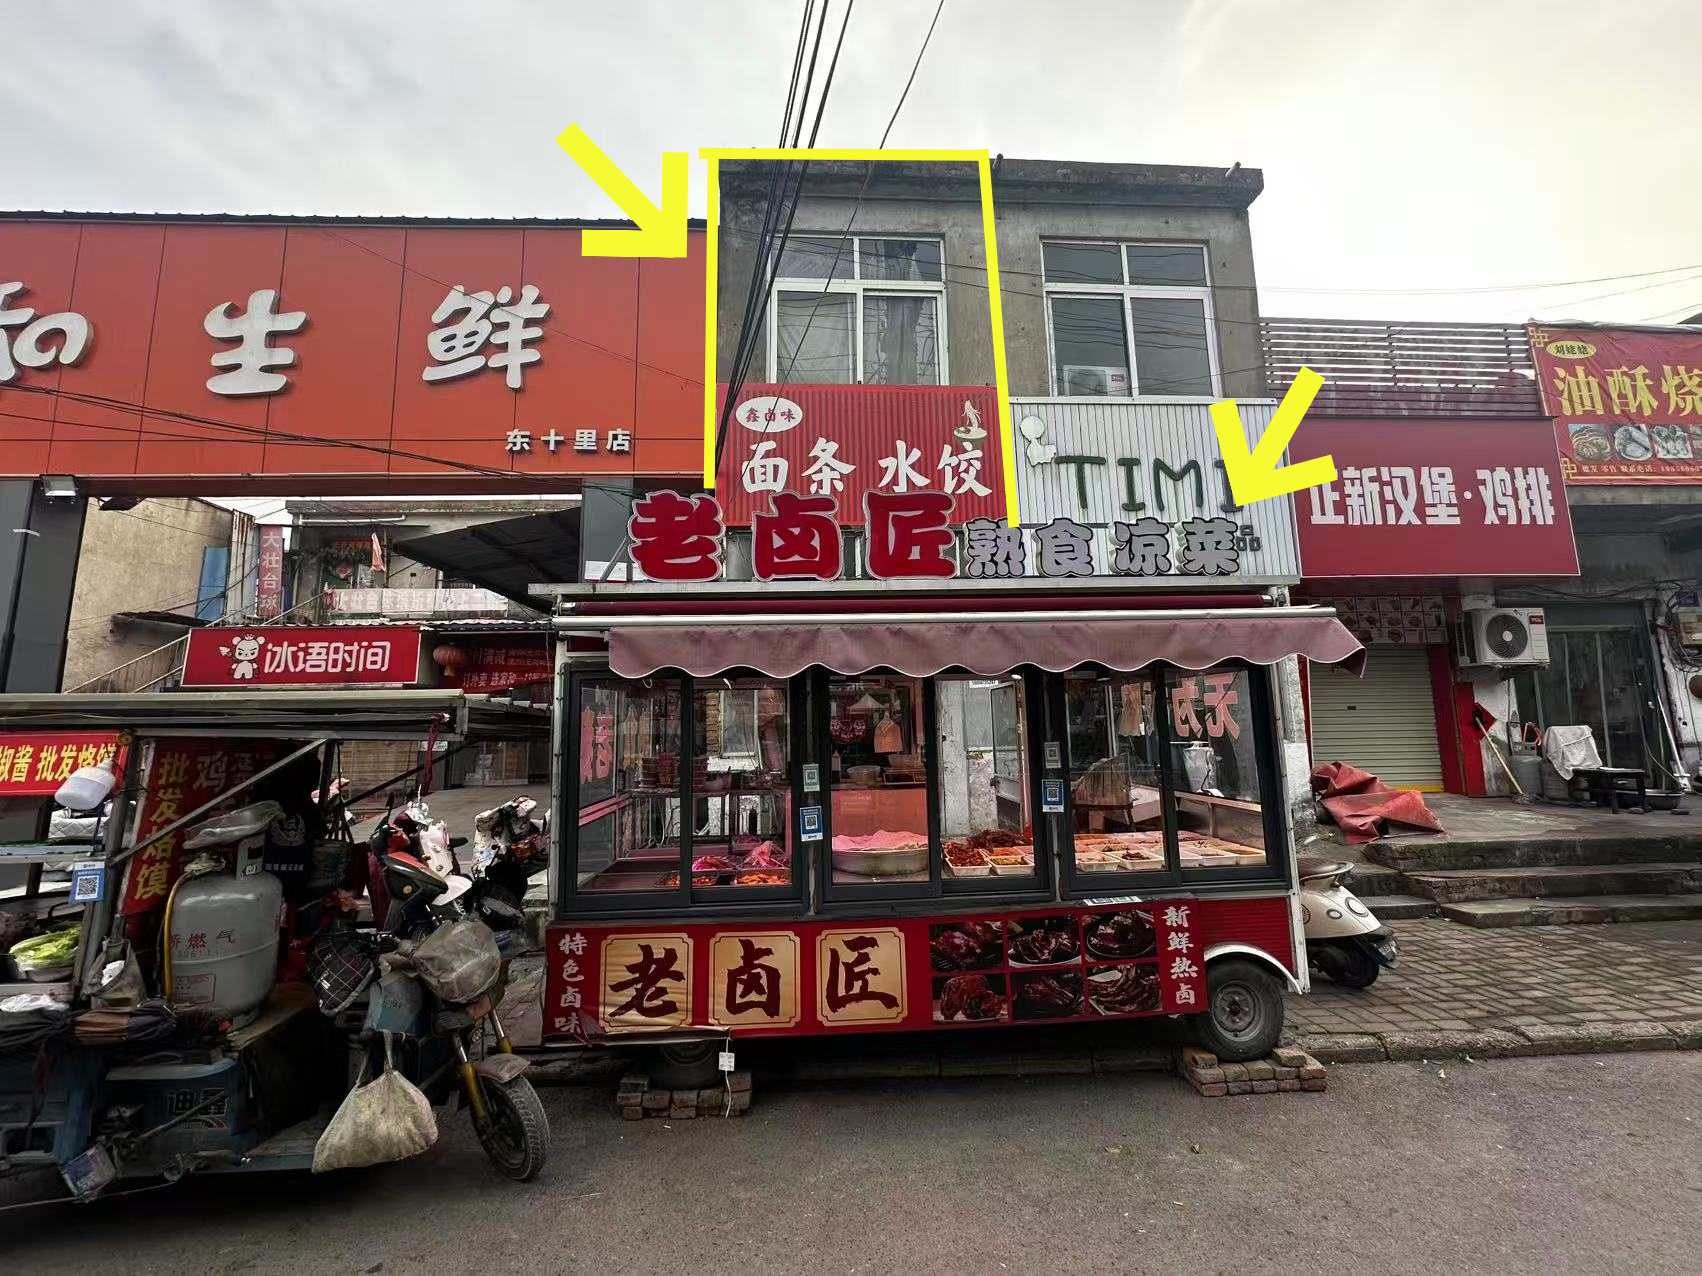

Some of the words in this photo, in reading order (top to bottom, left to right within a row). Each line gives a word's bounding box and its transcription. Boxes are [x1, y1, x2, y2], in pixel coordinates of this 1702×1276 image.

[505, 428, 632, 454] 东十里店
[745, 407, 796, 422] 鑫卤味
[741, 437, 856, 495] 面条
[878, 440, 992, 497] 水饺
[629, 489, 957, 581] 老卤匠
[965, 516, 1241, 578] 熟食凉菜
[264, 641, 391, 673] 冰语时间
[555, 932, 588, 1033] 特色卤味
[607, 936, 899, 1018] 老卤匠
[1161, 906, 1198, 1004] 新鲜热卤
